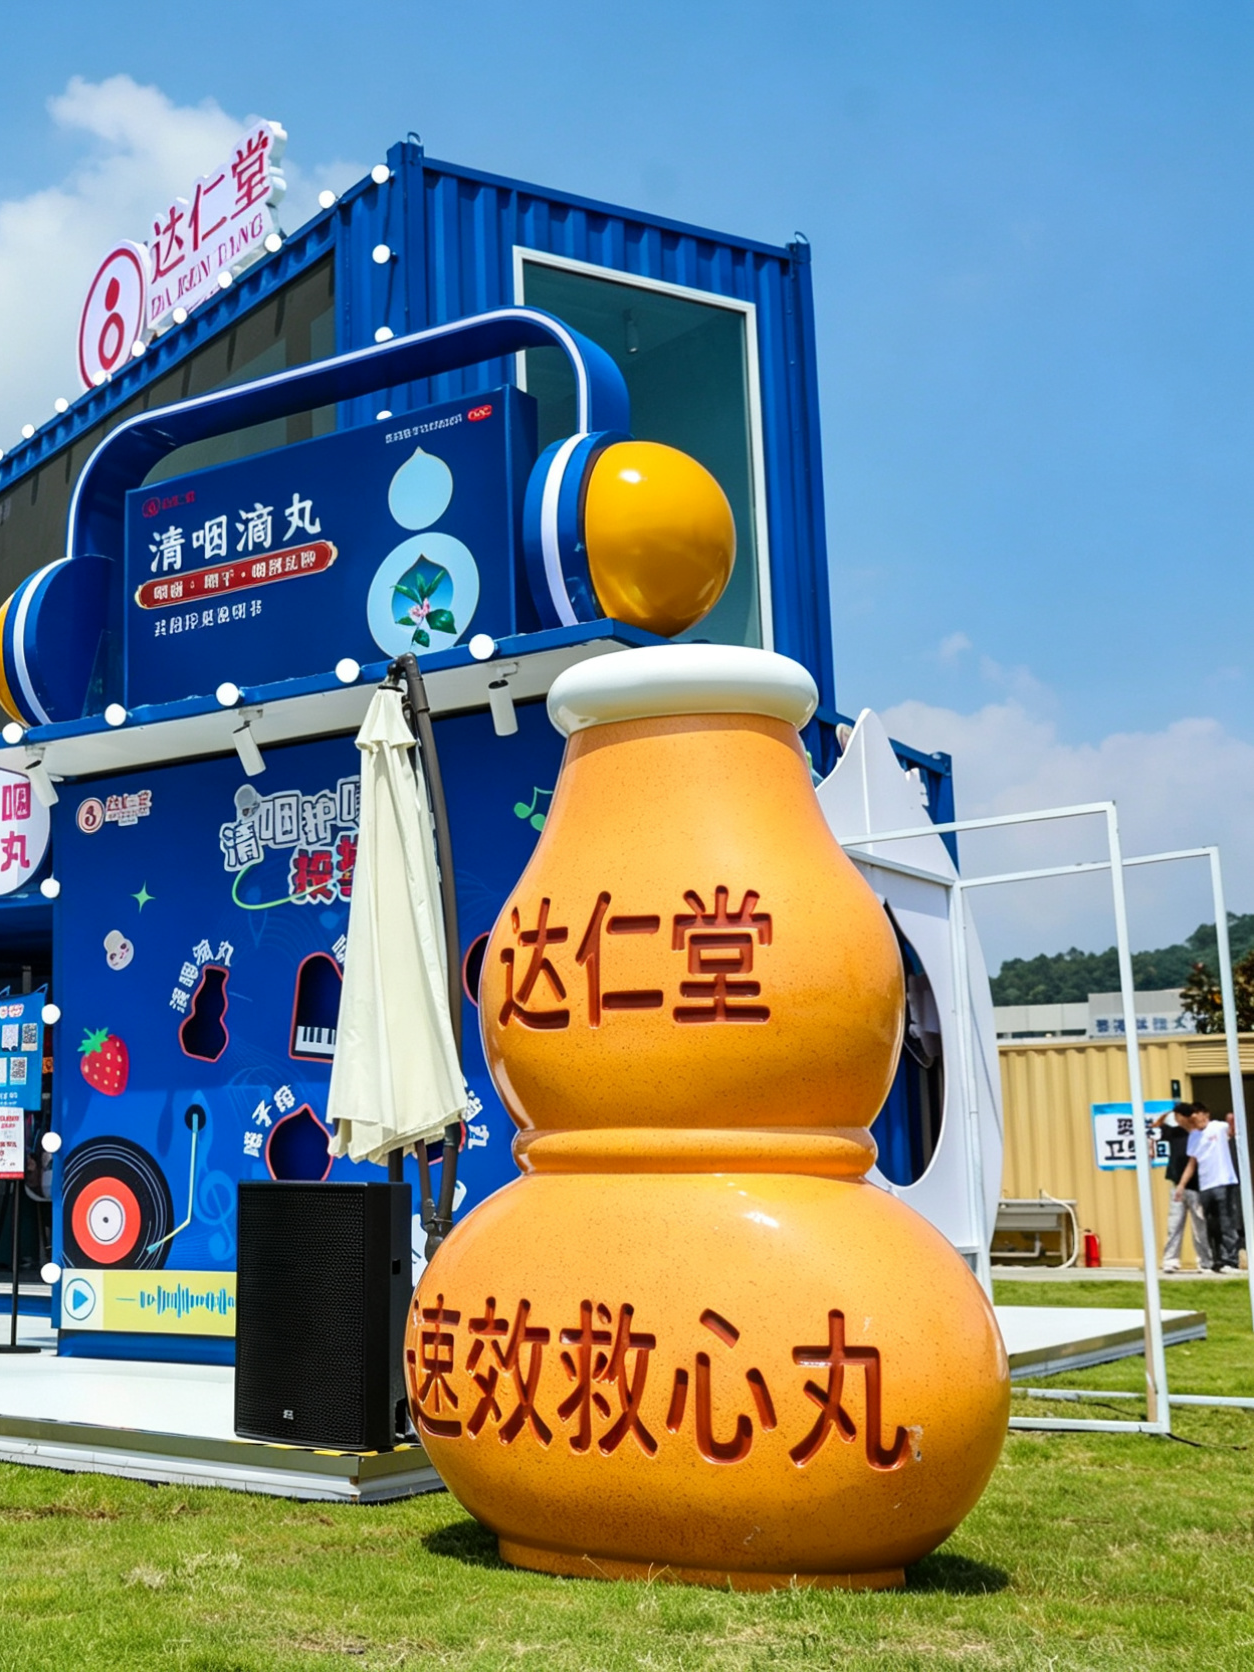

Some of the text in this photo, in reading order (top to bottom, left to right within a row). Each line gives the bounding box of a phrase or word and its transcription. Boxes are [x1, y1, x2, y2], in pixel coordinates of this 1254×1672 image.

[151, 129, 271, 285] 达仁堂
[148, 492, 322, 574] 清咽滴丸
[498, 885, 773, 1030] 达仁堂
[406, 1292, 912, 1471] 速效救心丸
